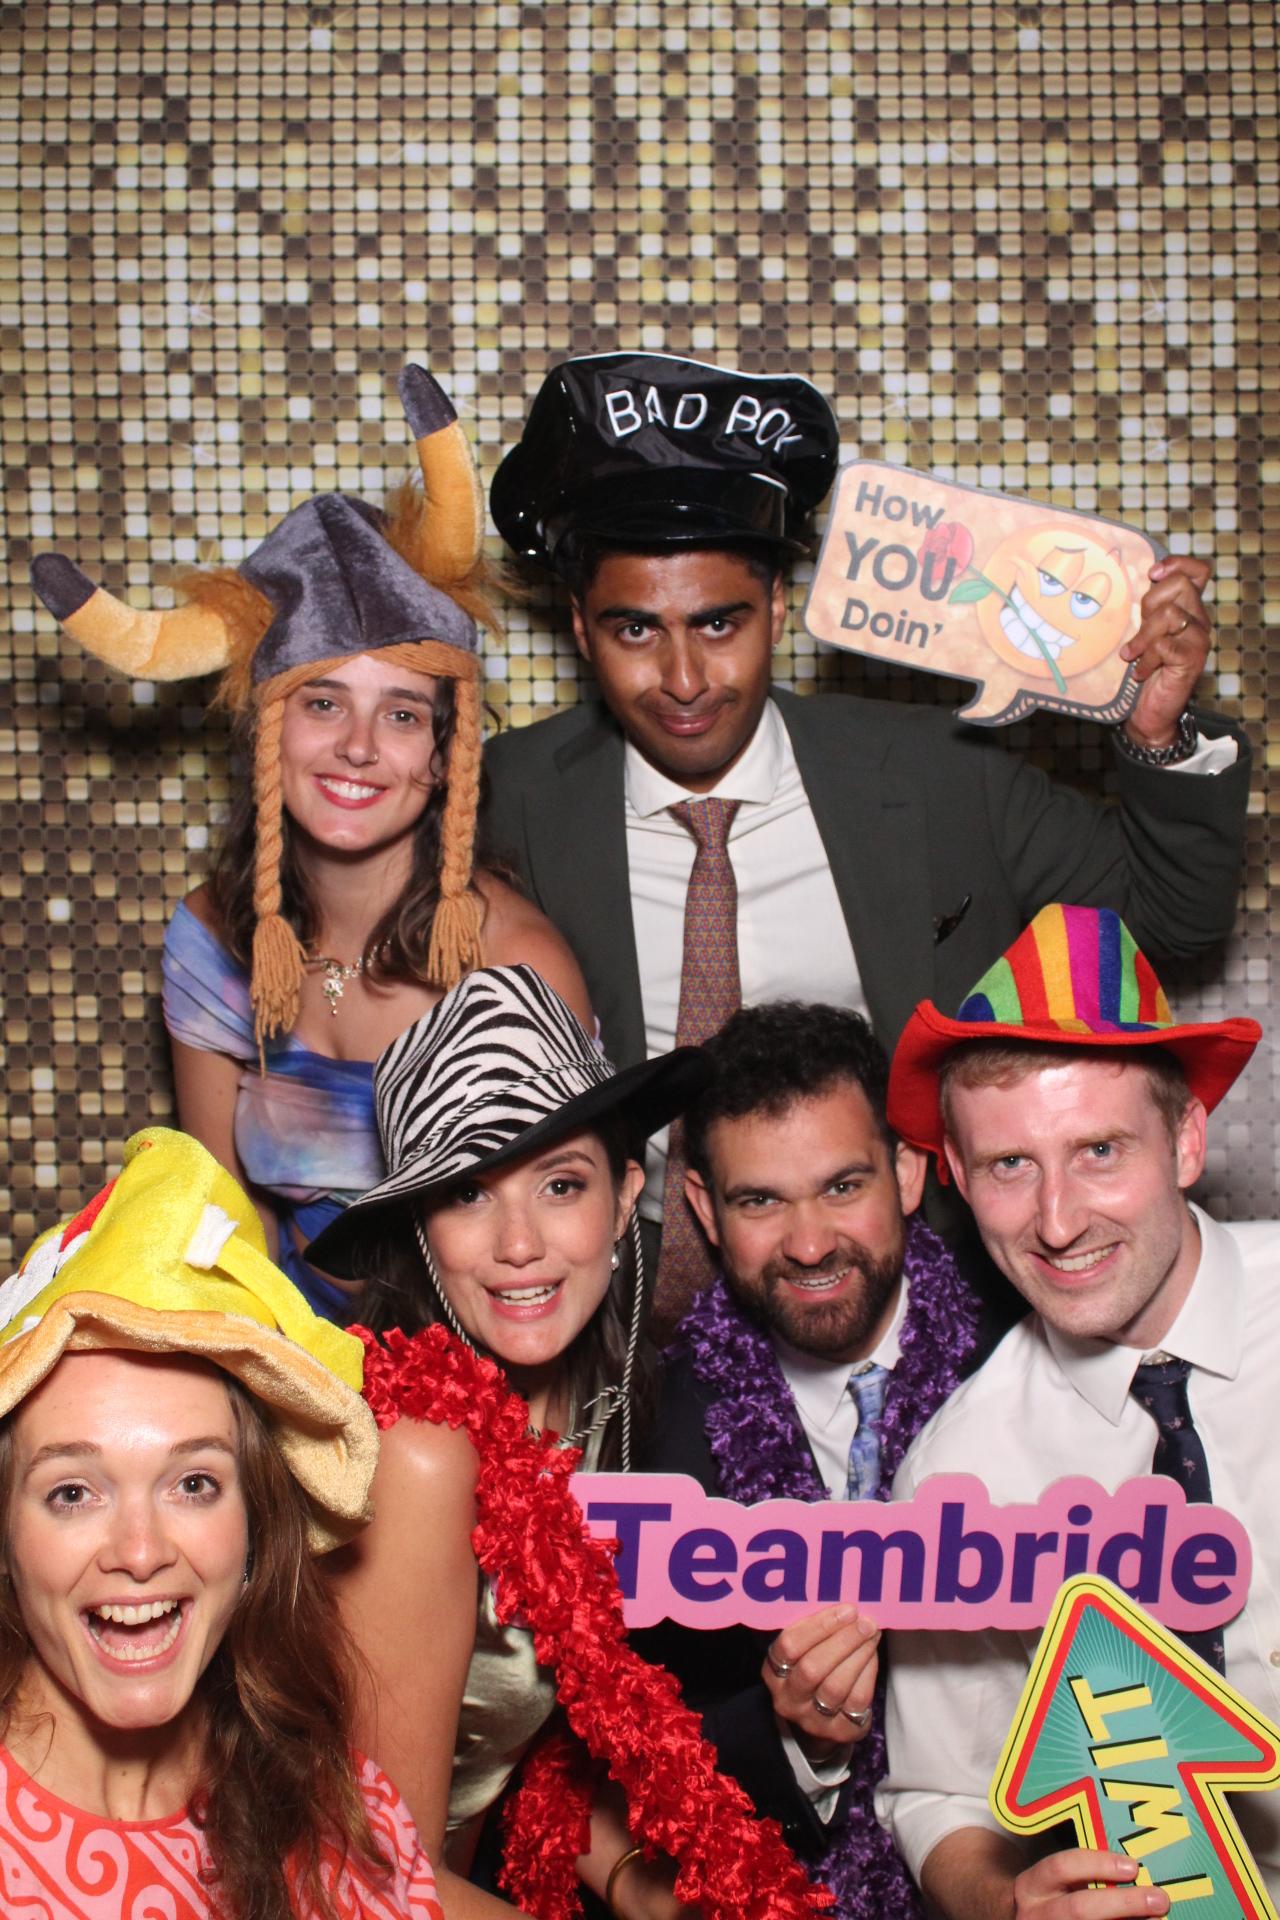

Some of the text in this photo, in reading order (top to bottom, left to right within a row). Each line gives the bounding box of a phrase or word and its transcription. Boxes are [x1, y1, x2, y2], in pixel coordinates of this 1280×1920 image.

[605, 386, 803, 454] BAD BOY
[855, 481, 945, 529] How
[844, 531, 957, 602] YOU
[586, 1502, 1237, 1605] Teambride
